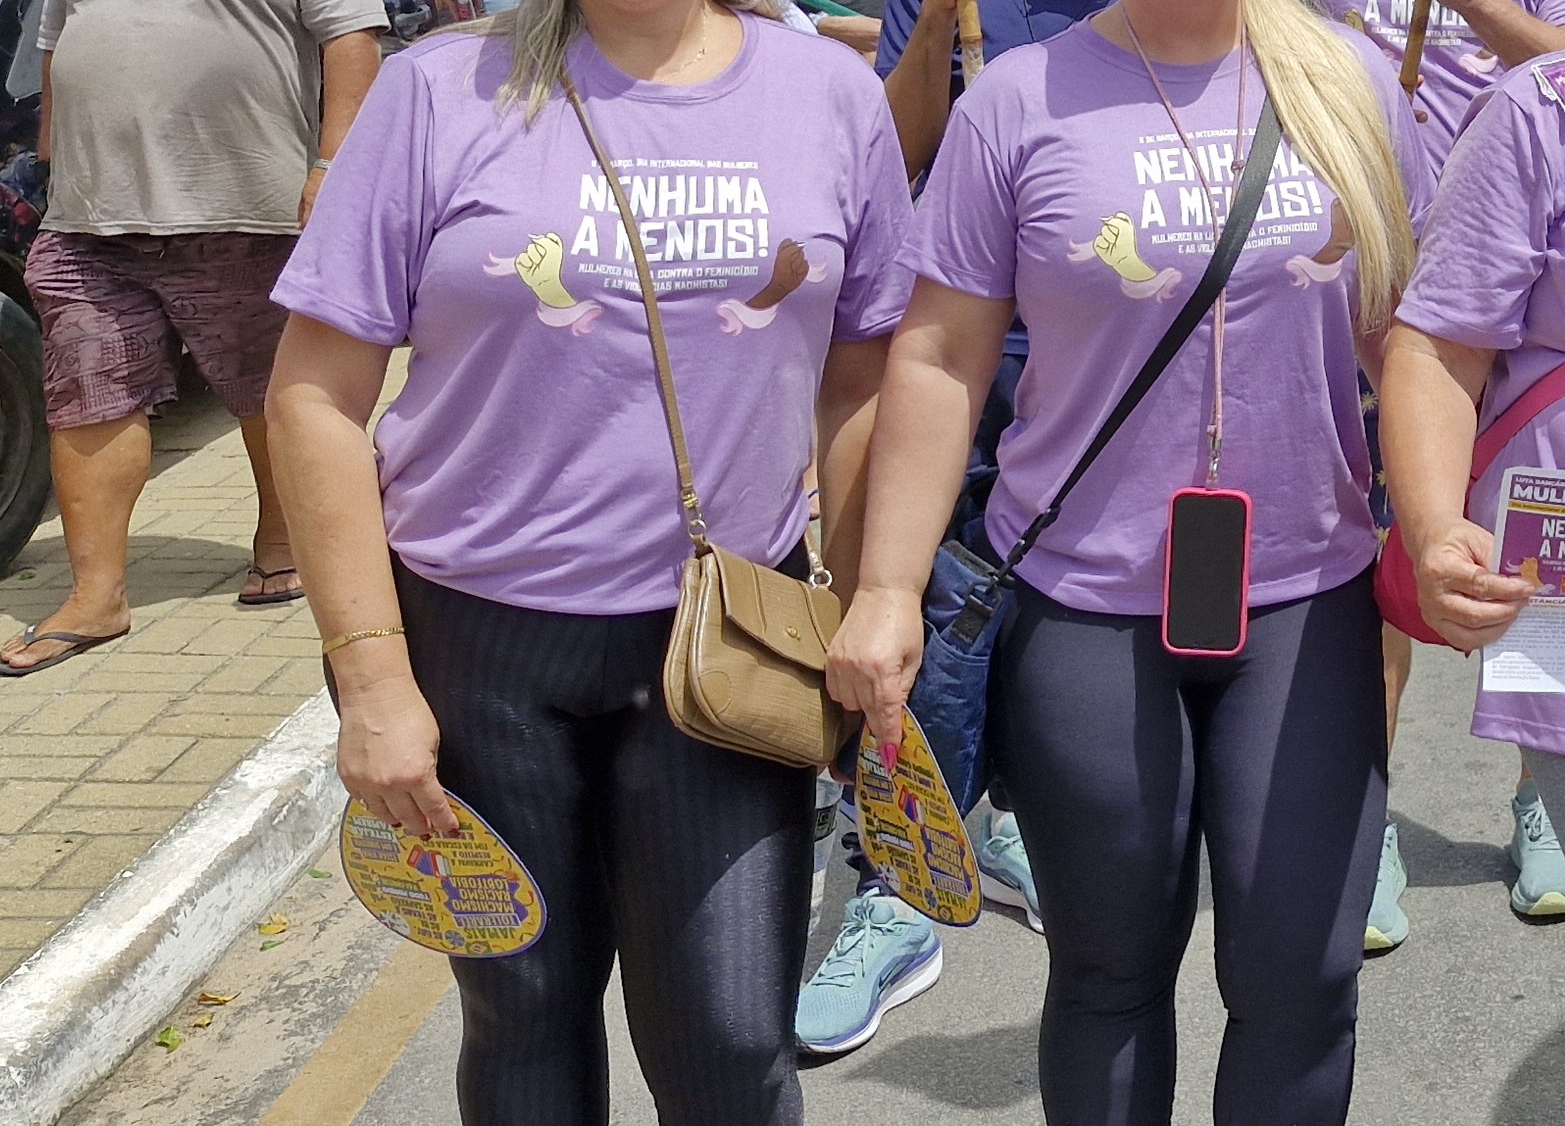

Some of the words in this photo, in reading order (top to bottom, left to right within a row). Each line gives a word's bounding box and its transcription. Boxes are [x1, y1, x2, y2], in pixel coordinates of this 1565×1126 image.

[1133, 141, 1316, 185] NENHMA
[1140, 188, 1167, 229] A
[570, 214, 599, 257] A
[1538, 538, 1551, 559] A
[460, 887, 512, 902] RACISMO
[451, 898, 515, 914] MACHISMO
[463, 926, 516, 941] JAMAIS
